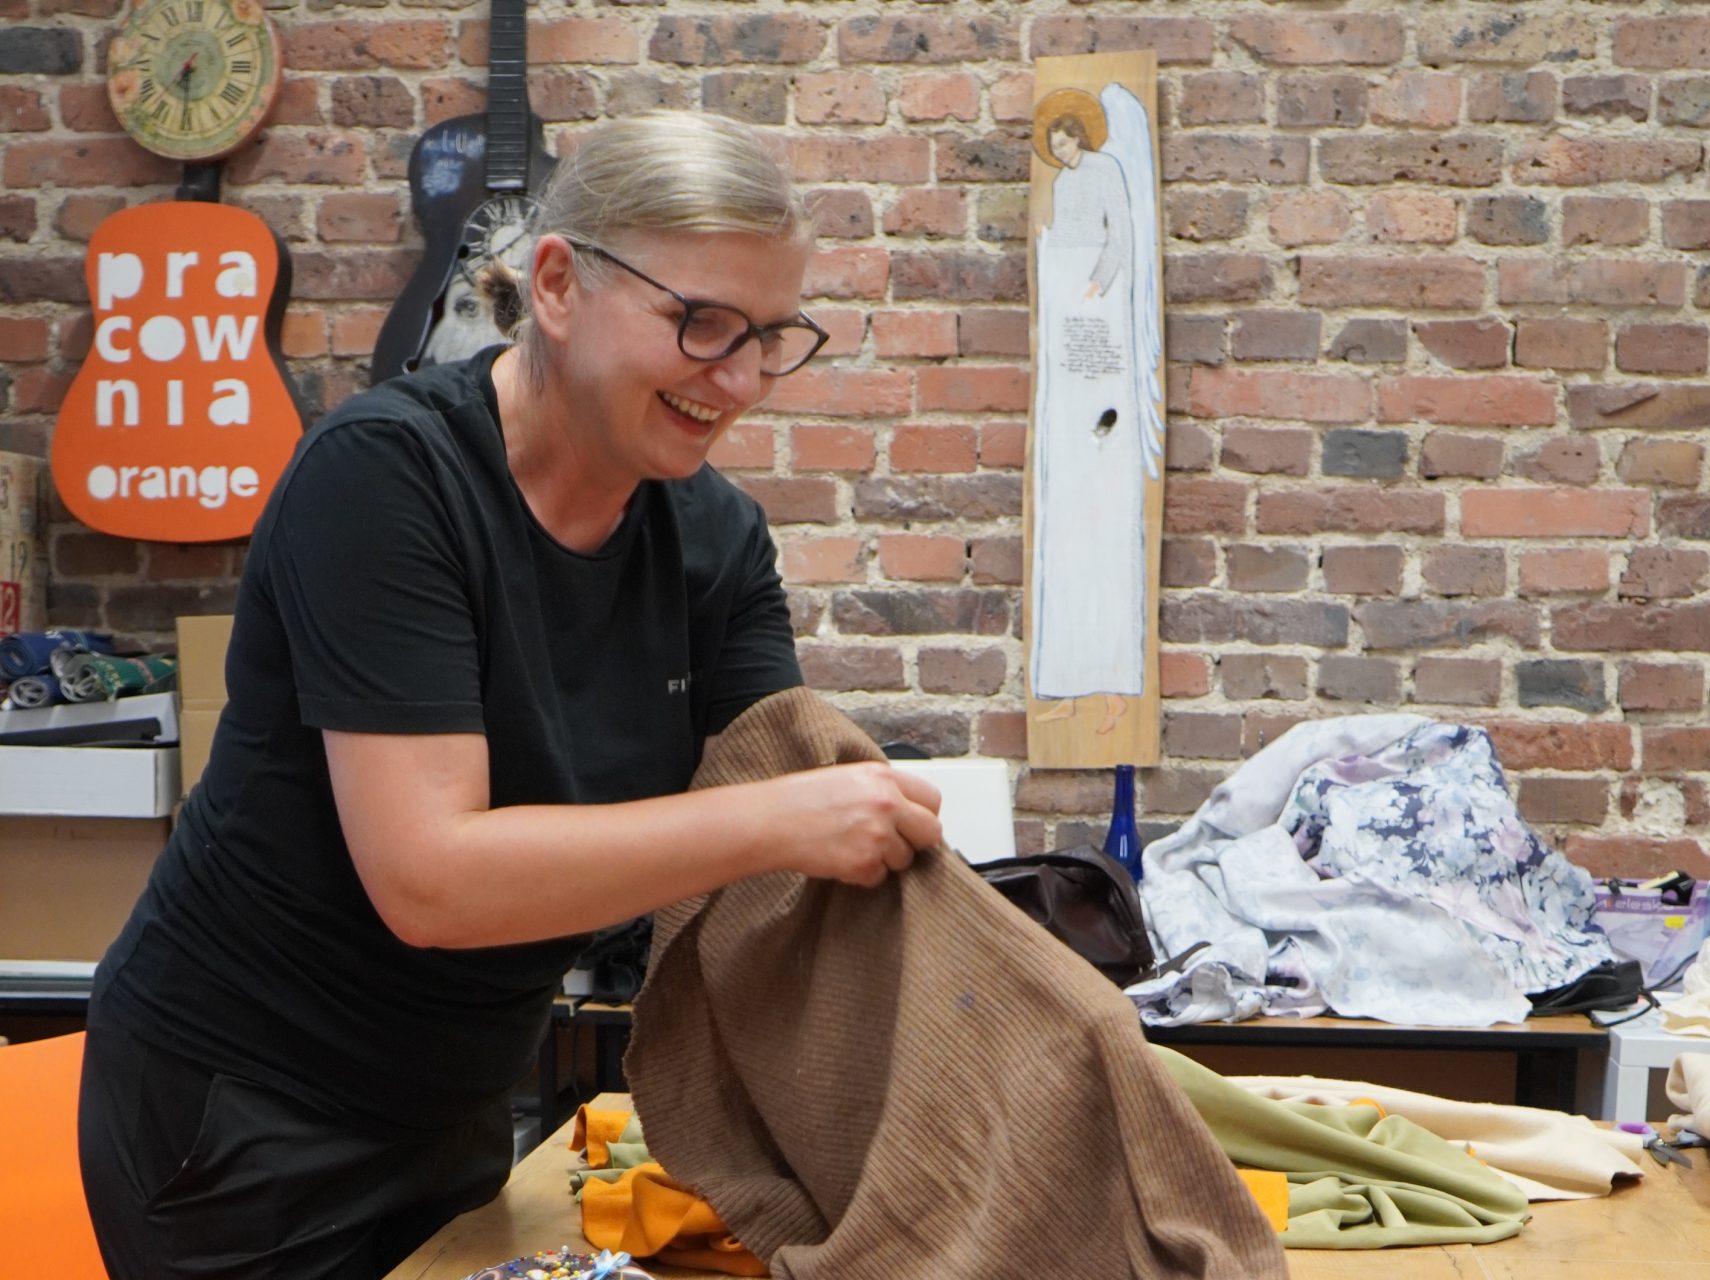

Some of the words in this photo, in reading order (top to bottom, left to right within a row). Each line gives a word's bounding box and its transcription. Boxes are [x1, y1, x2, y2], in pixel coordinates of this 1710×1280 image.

[97, 251, 258, 311] pra
[95, 315, 259, 363] cow
[87, 465, 259, 510] orange
